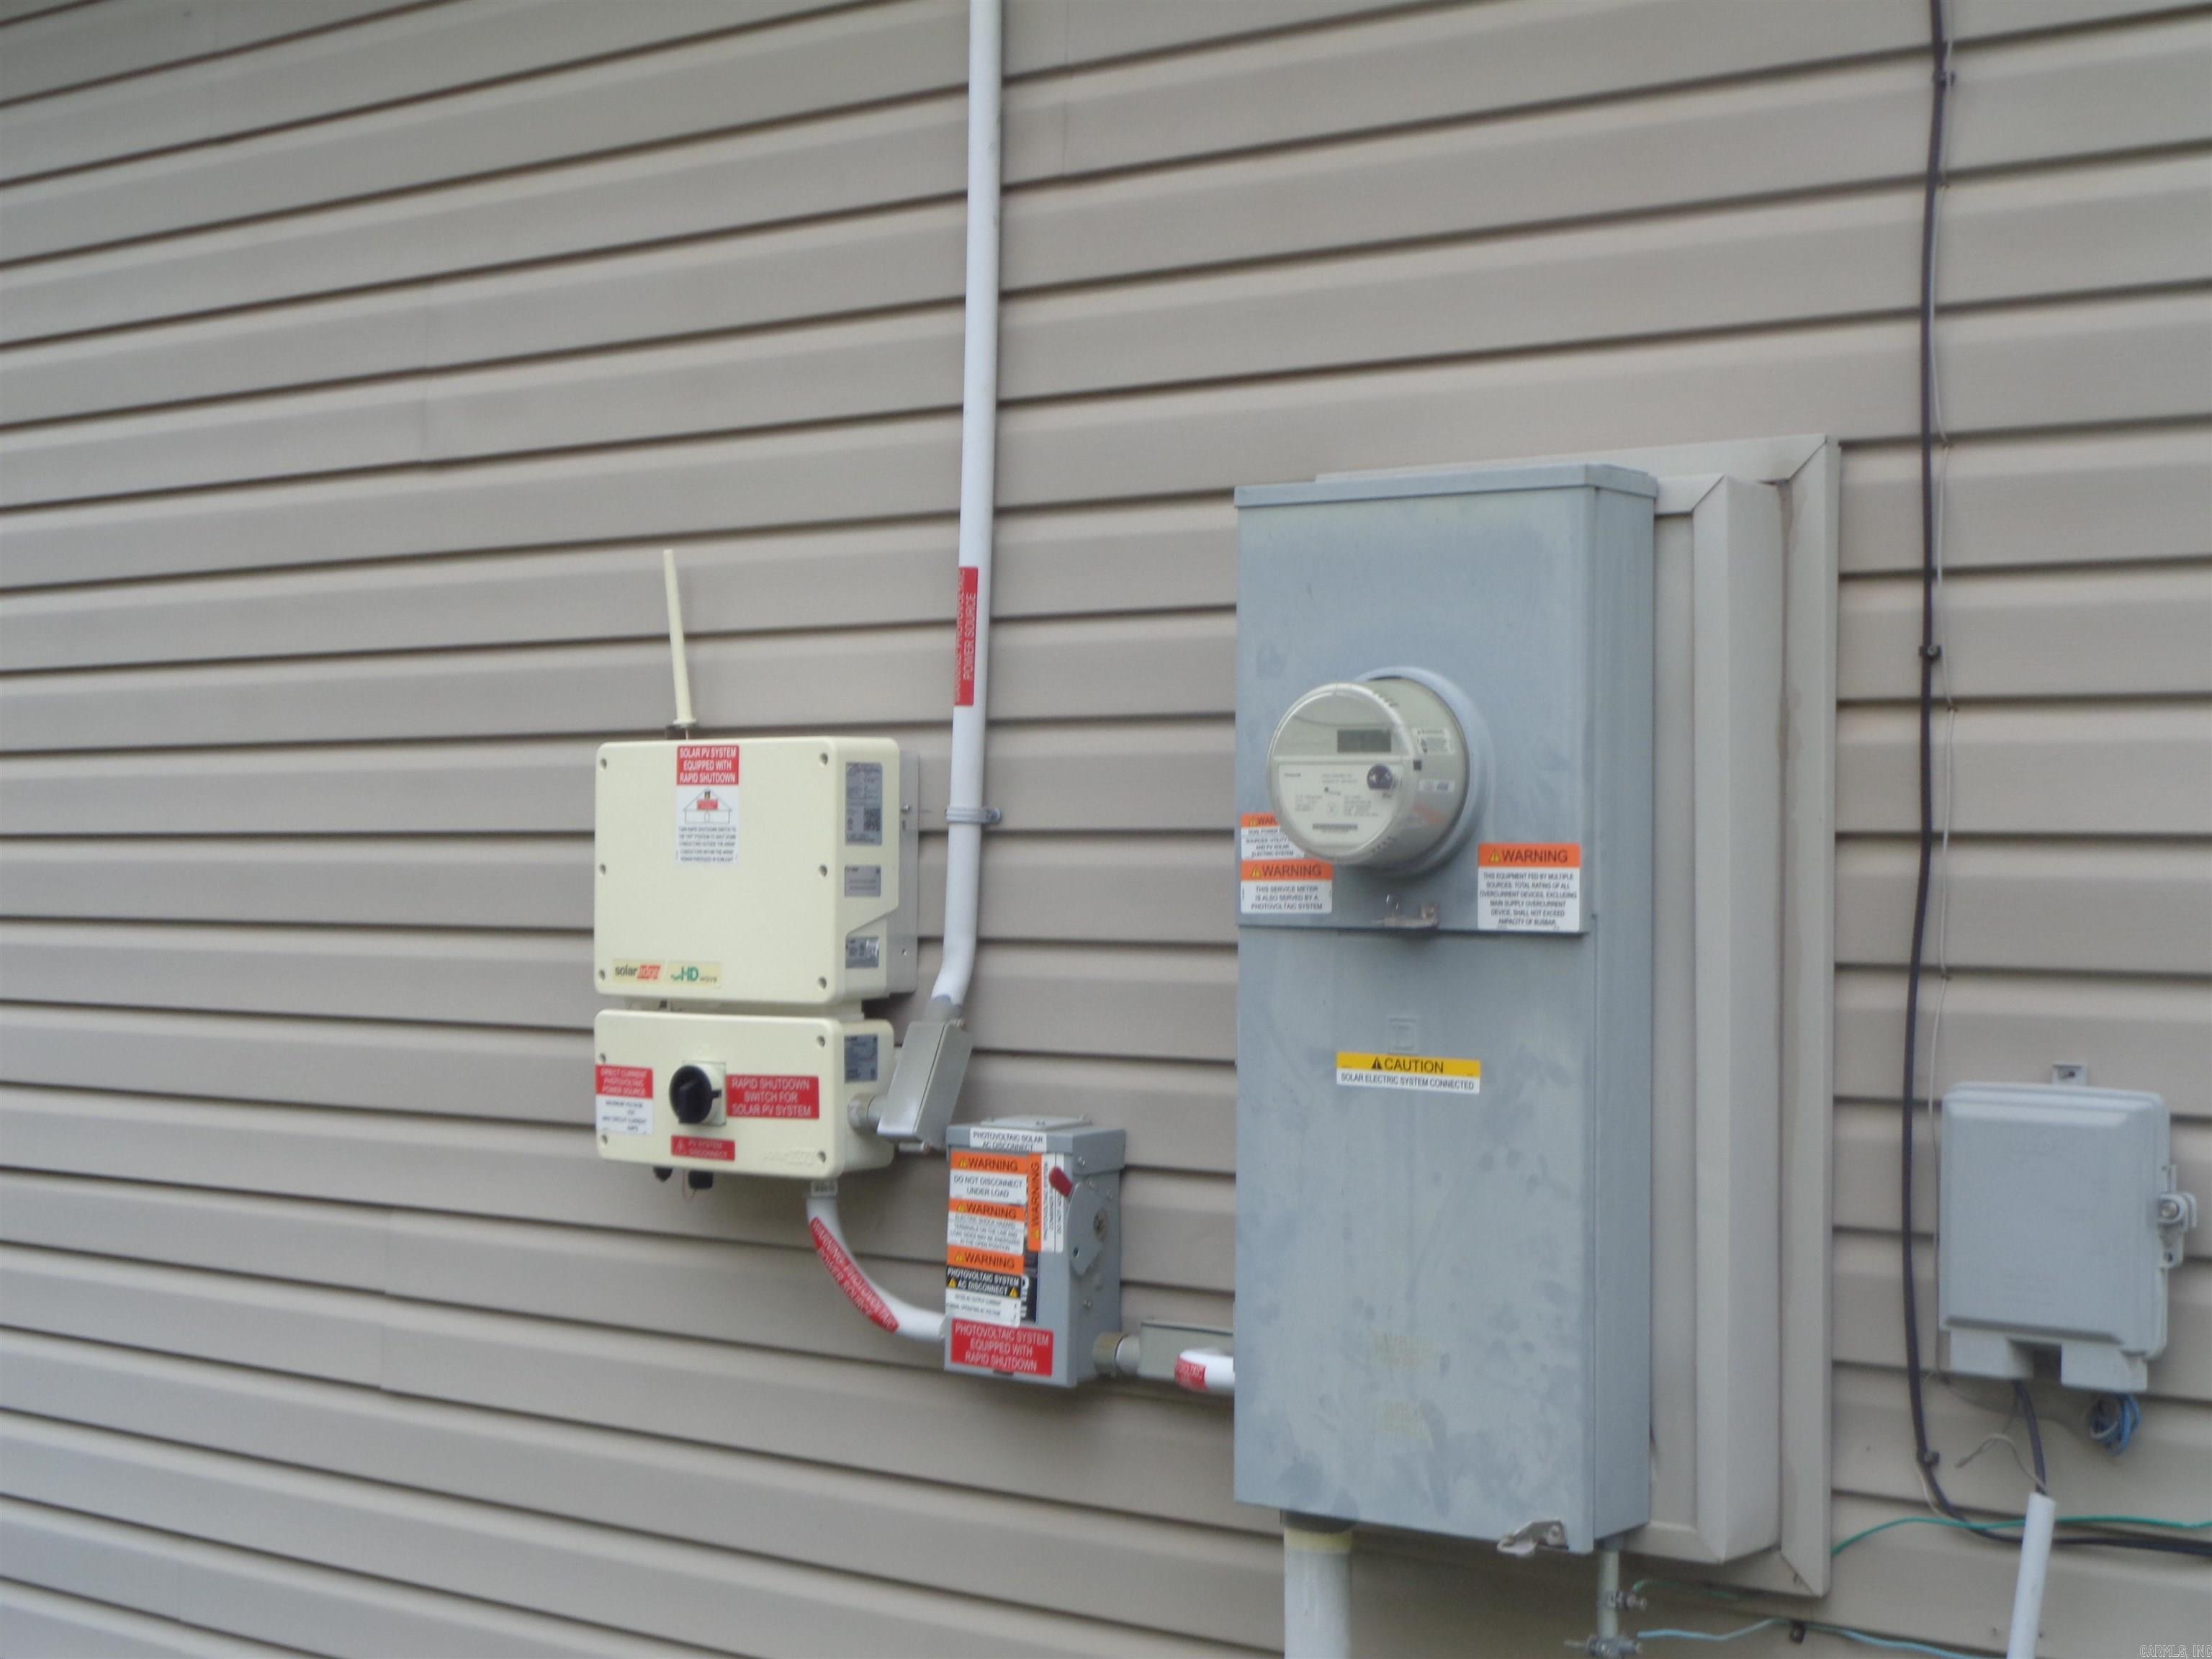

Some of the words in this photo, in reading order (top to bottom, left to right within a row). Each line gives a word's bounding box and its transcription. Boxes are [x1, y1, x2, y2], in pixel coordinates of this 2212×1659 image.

[965, 593, 976, 638] SOURCE
[679, 747, 700, 758] SOLAR
[701, 747, 710, 758] PV
[711, 747, 737, 757] SYSTEM
[683, 760, 714, 770] EQUIPPED
[715, 759, 732, 770] WITH
[679, 773, 698, 784] RAPID
[699, 772, 736, 783] SHUTDOWN
[1502, 849, 1568, 863] WARNING
[1262, 864, 1322, 877] WARNING
[681, 966, 698, 981] HD
[1384, 1057, 1444, 1074] CAUTION
[732, 1077, 757, 1089] RAPID
[760, 1077, 810, 1090] SHUTDOWN
[1341, 1072, 1364, 1082] SOLAR
[1365, 1074, 1398, 1084] ELECTRIC
[1400, 1076, 1429, 1087] SYSTEM
[1429, 1078, 1474, 1090] CONNECTED
[744, 1091, 777, 1102] SWITCH
[779, 1091, 799, 1103] FOR
[732, 1103, 760, 1115] SOLAR
[762, 1104, 774, 1115] PV
[775, 1105, 811, 1117] SYSTEM
[973, 1131, 1020, 1142] PHOTOVOLTAIC
[1021, 1133, 1043, 1143] SOLAR
[968, 1157, 1018, 1172] WARNING
[953, 1174, 963, 1183] DO
[965, 1176, 979, 1184] NOT
[980, 1177, 1022, 1189] DISCONNECT
[966, 1187, 989, 1196] UNDER
[991, 1188, 1010, 1197] LOAD
[967, 1202, 1016, 1219] WARNING
[965, 1252, 1015, 1269] WARNING
[948, 1267, 993, 1282] PHOTOVOLTAIC
[994, 1274, 1019, 1286] SYSTEM
[958, 1280, 967, 1289] AC
[968, 1282, 1007, 1295] DISCONNECT
[955, 1321, 1015, 1341] PHOTOVOLTAIC
[1016, 1331, 1049, 1346] SYSTEM
[970, 1338, 1010, 1353] EQUIPPED
[1012, 1343, 1033, 1357] WITH
[965, 1350, 989, 1364] RAPID
[990, 1354, 1037, 1372] SHUTDOWN
